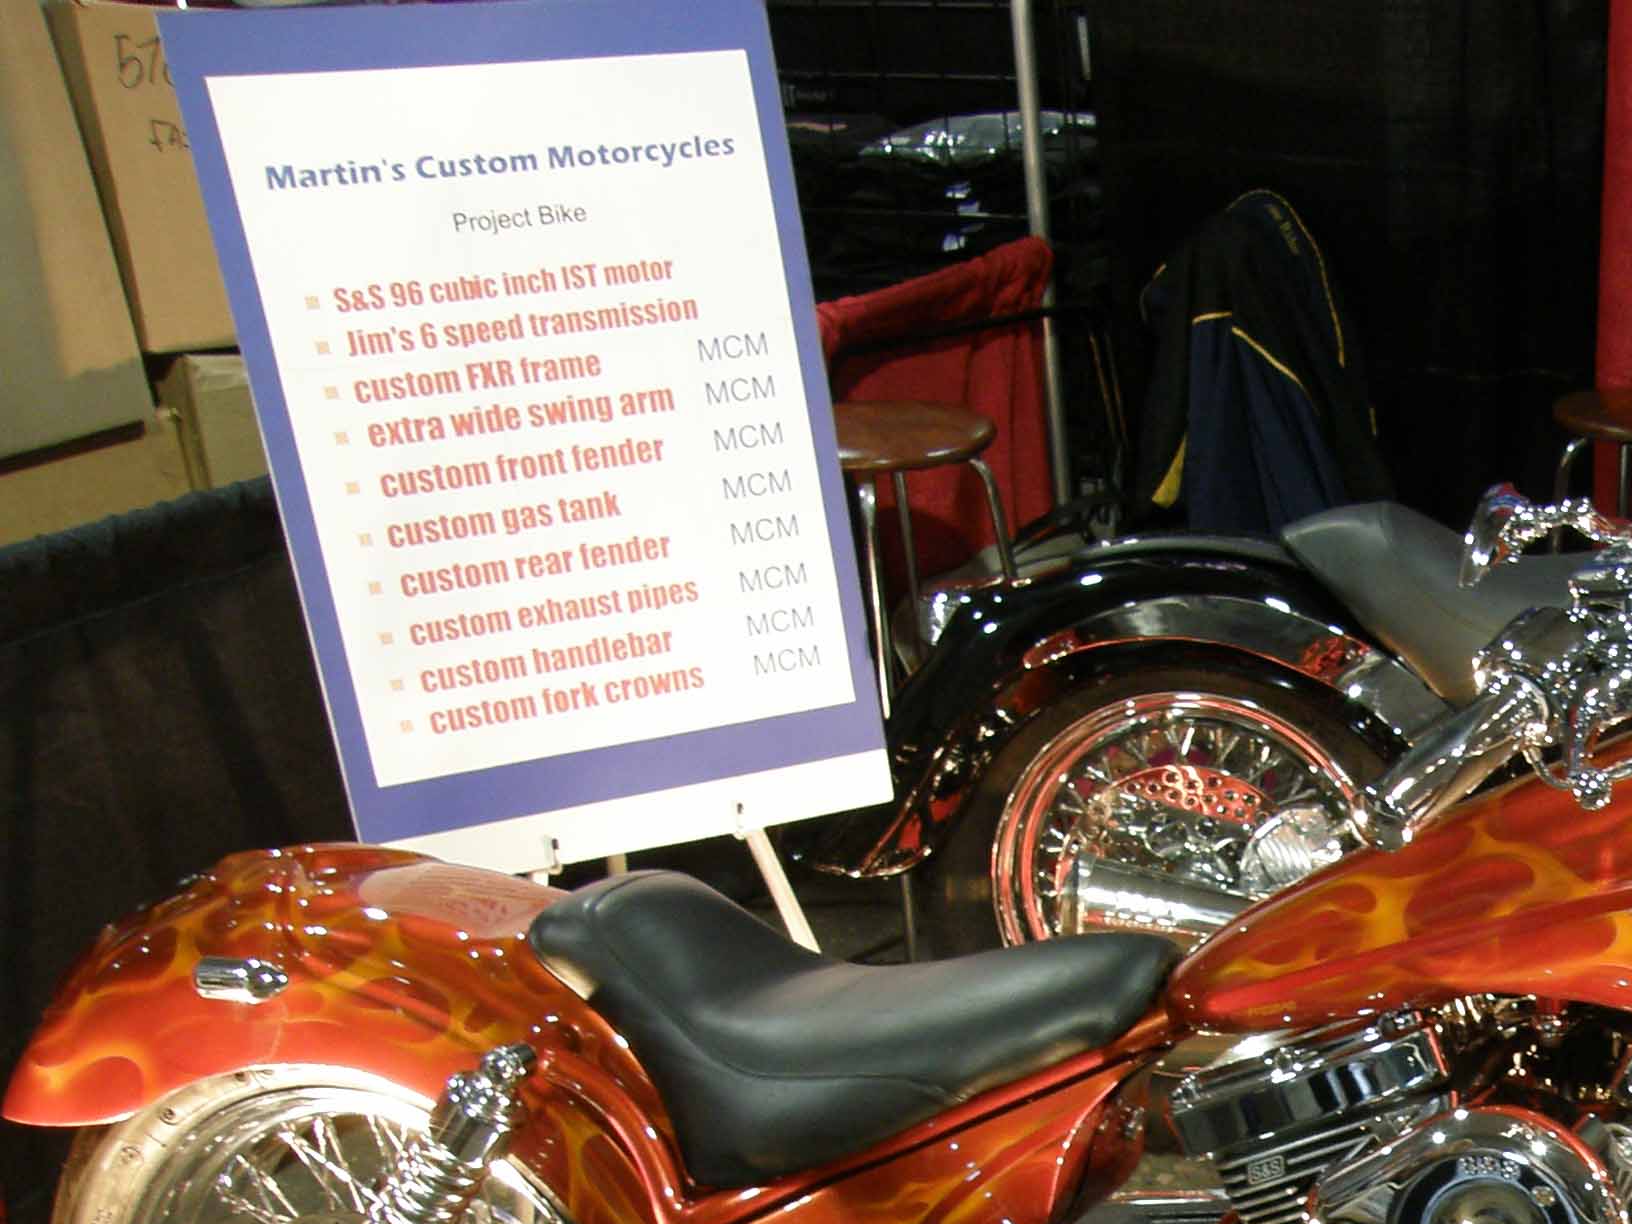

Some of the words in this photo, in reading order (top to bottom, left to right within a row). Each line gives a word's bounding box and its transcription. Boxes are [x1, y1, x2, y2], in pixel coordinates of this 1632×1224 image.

[265, 158, 406, 190] Martin's
[416, 153, 538, 179] Custom
[547, 136, 735, 169] Motorcycles
[453, 208, 533, 234] Project
[538, 204, 587, 225] Bike
[333, 284, 386, 313] S&S
[390, 280, 424, 307] 96
[429, 275, 498, 303] cubic
[502, 268, 557, 296] inch
[604, 259, 673, 286] motor
[347, 326, 415, 357] Jim's
[420, 322, 438, 349] 6
[444, 314, 525, 348] speed
[528, 298, 699, 337] transmission
[354, 370, 461, 403] custom
[465, 360, 516, 391] FXR
[520, 354, 601, 384] frame
[697, 332, 769, 362] MCM
[368, 415, 445, 447] extra
[450, 404, 522, 437] wide
[527, 395, 613, 428] swing
[620, 388, 675, 417] arm
[705, 375, 776, 405] MCM
[380, 461, 491, 498] custom
[496, 448, 568, 483] front
[572, 438, 664, 472] fender
[713, 422, 784, 452] MCM
[387, 511, 496, 548] custom
[502, 503, 553, 535] gas
[558, 491, 622, 523] tank
[722, 469, 792, 500] MCM
[400, 559, 510, 598] custom
[515, 550, 573, 580] rear
[579, 535, 671, 571] fender
[730, 514, 800, 545] MCM
[409, 609, 512, 646] custom
[517, 589, 623, 629] exhaust
[627, 580, 699, 614] pipes
[739, 562, 808, 593] MCM
[420, 654, 528, 693] custom
[532, 631, 672, 675] handlebar
[747, 606, 815, 636] MCM
[430, 695, 537, 734] custom
[542, 681, 600, 715] fork
[604, 666, 704, 705] crowns
[753, 645, 821, 676] MCM
[1250, 1158, 1283, 1183] S&S
